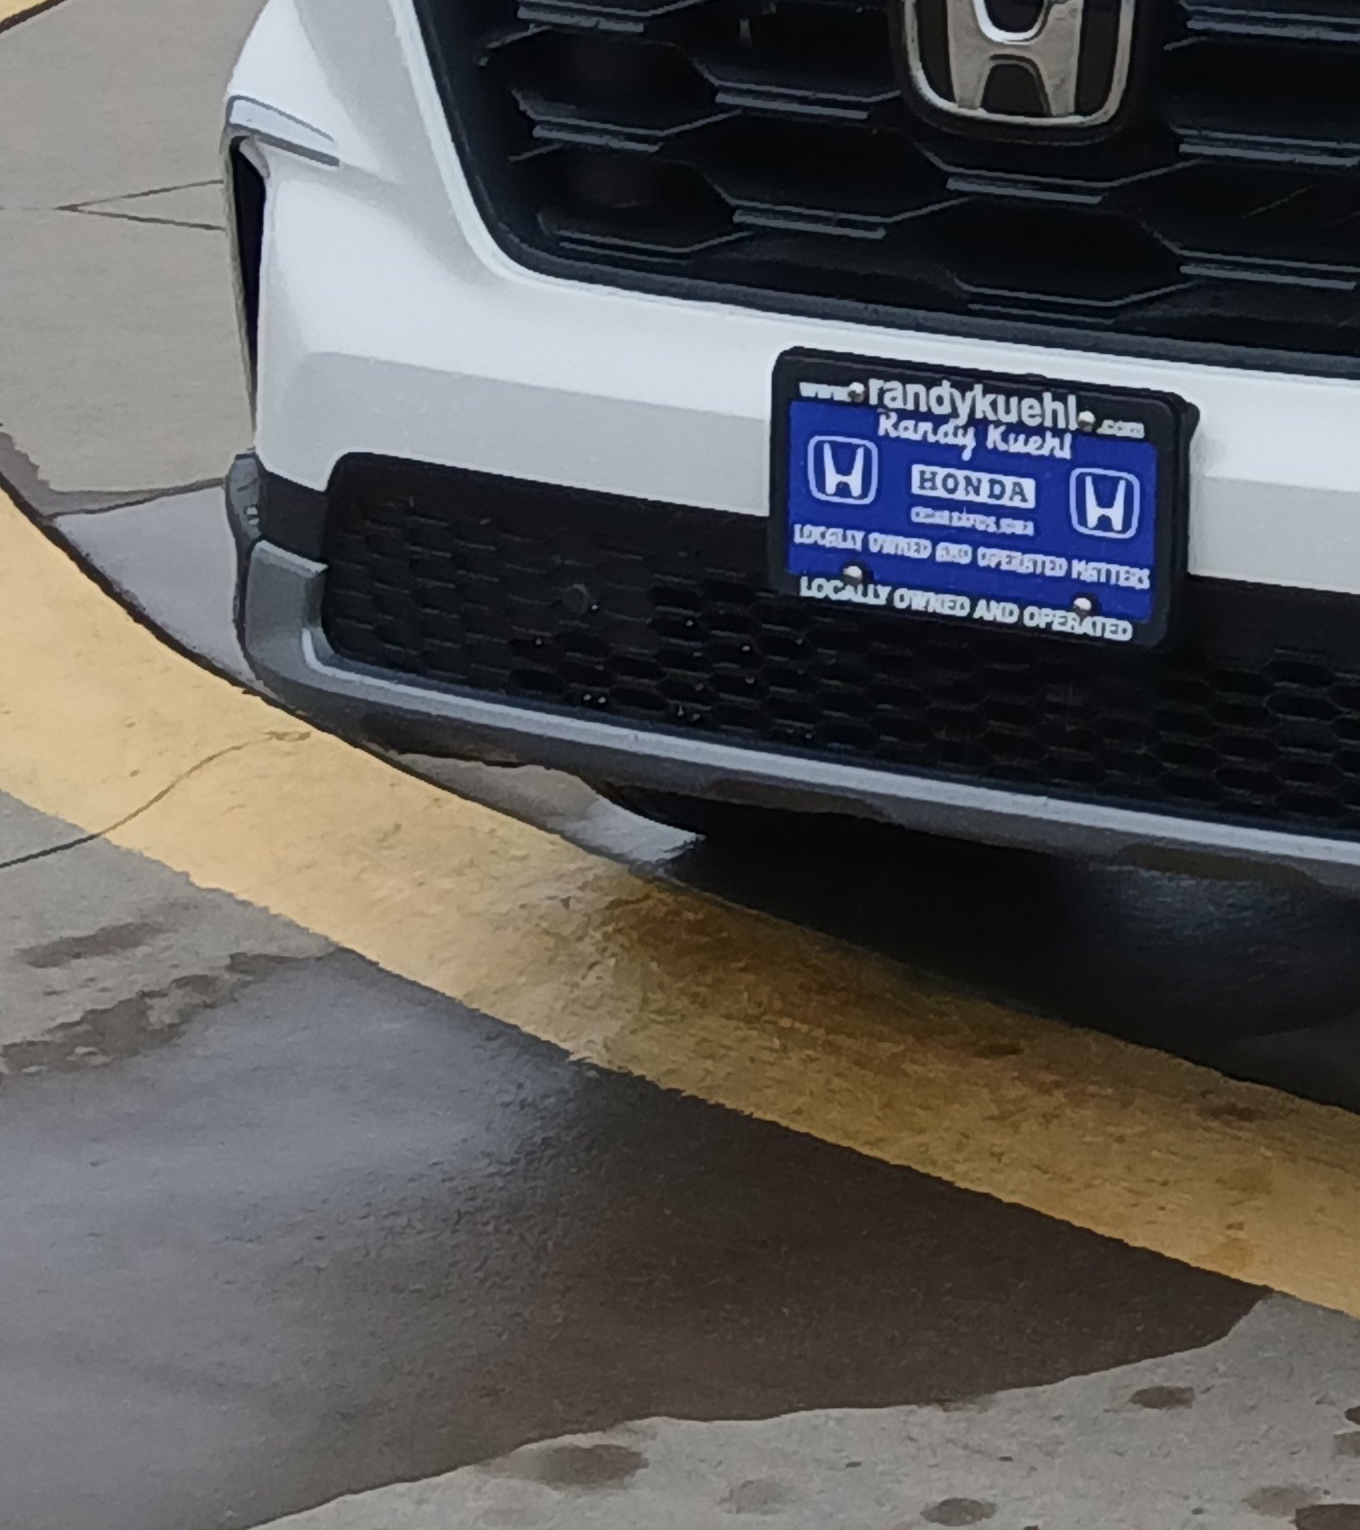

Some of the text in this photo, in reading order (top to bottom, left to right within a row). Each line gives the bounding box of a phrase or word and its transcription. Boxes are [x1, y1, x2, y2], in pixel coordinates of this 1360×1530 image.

[867, 378, 1079, 431] randykuehl
[877, 408, 1073, 461] Randy Kuehl
[918, 469, 1029, 504] HONDA
[800, 576, 1133, 642] LOCALLY OWNED AND OPERATED
